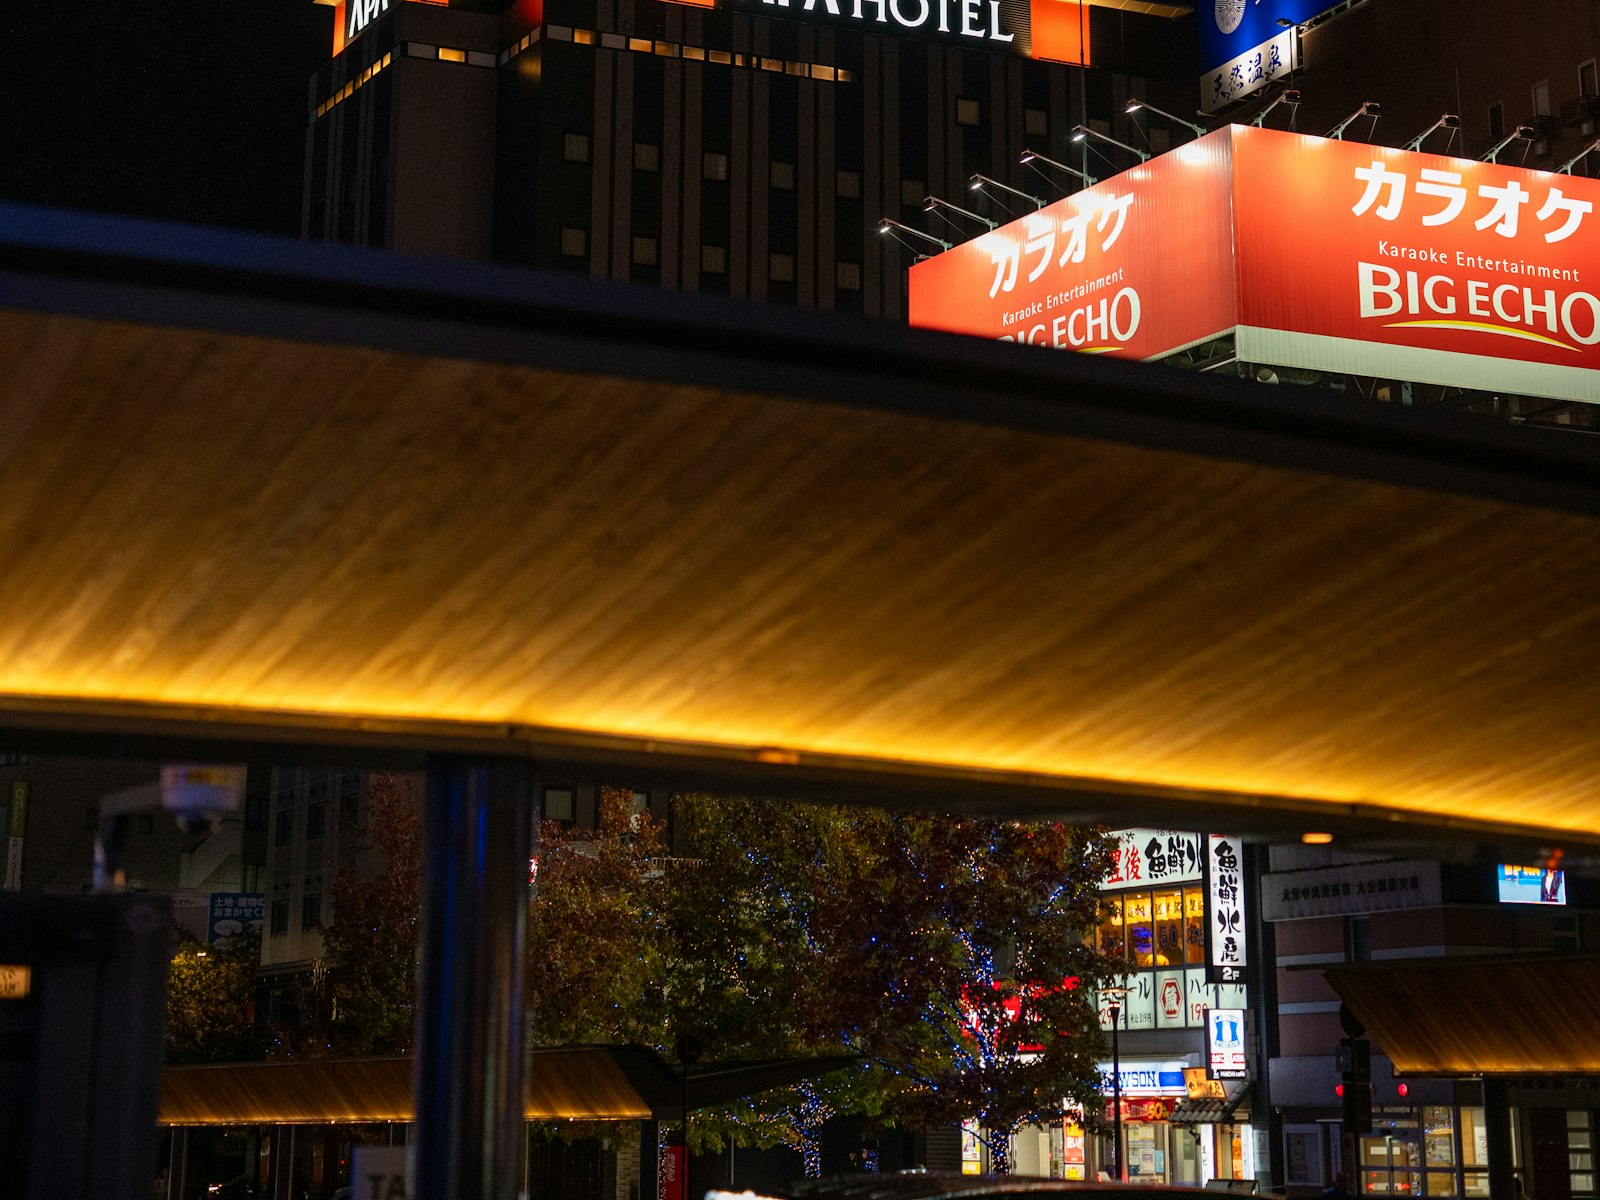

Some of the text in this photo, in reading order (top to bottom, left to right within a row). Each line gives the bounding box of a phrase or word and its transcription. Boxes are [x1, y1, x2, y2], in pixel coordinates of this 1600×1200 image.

[1212, 43, 1284, 105] 天然温泉
[1352, 160, 1593, 244] カラオケ
[989, 192, 1135, 299] カラオケ
[1378, 240, 1580, 282] Karaoke Entertainment
[1002, 267, 1124, 327] Karaoke Entertainment
[1053, 286, 1141, 350] ECHO
[1358, 261, 1600, 346] BIG ECHO
[1214, 839, 1242, 963] 魚鮮水産
[1222, 966, 1241, 981] 2F
